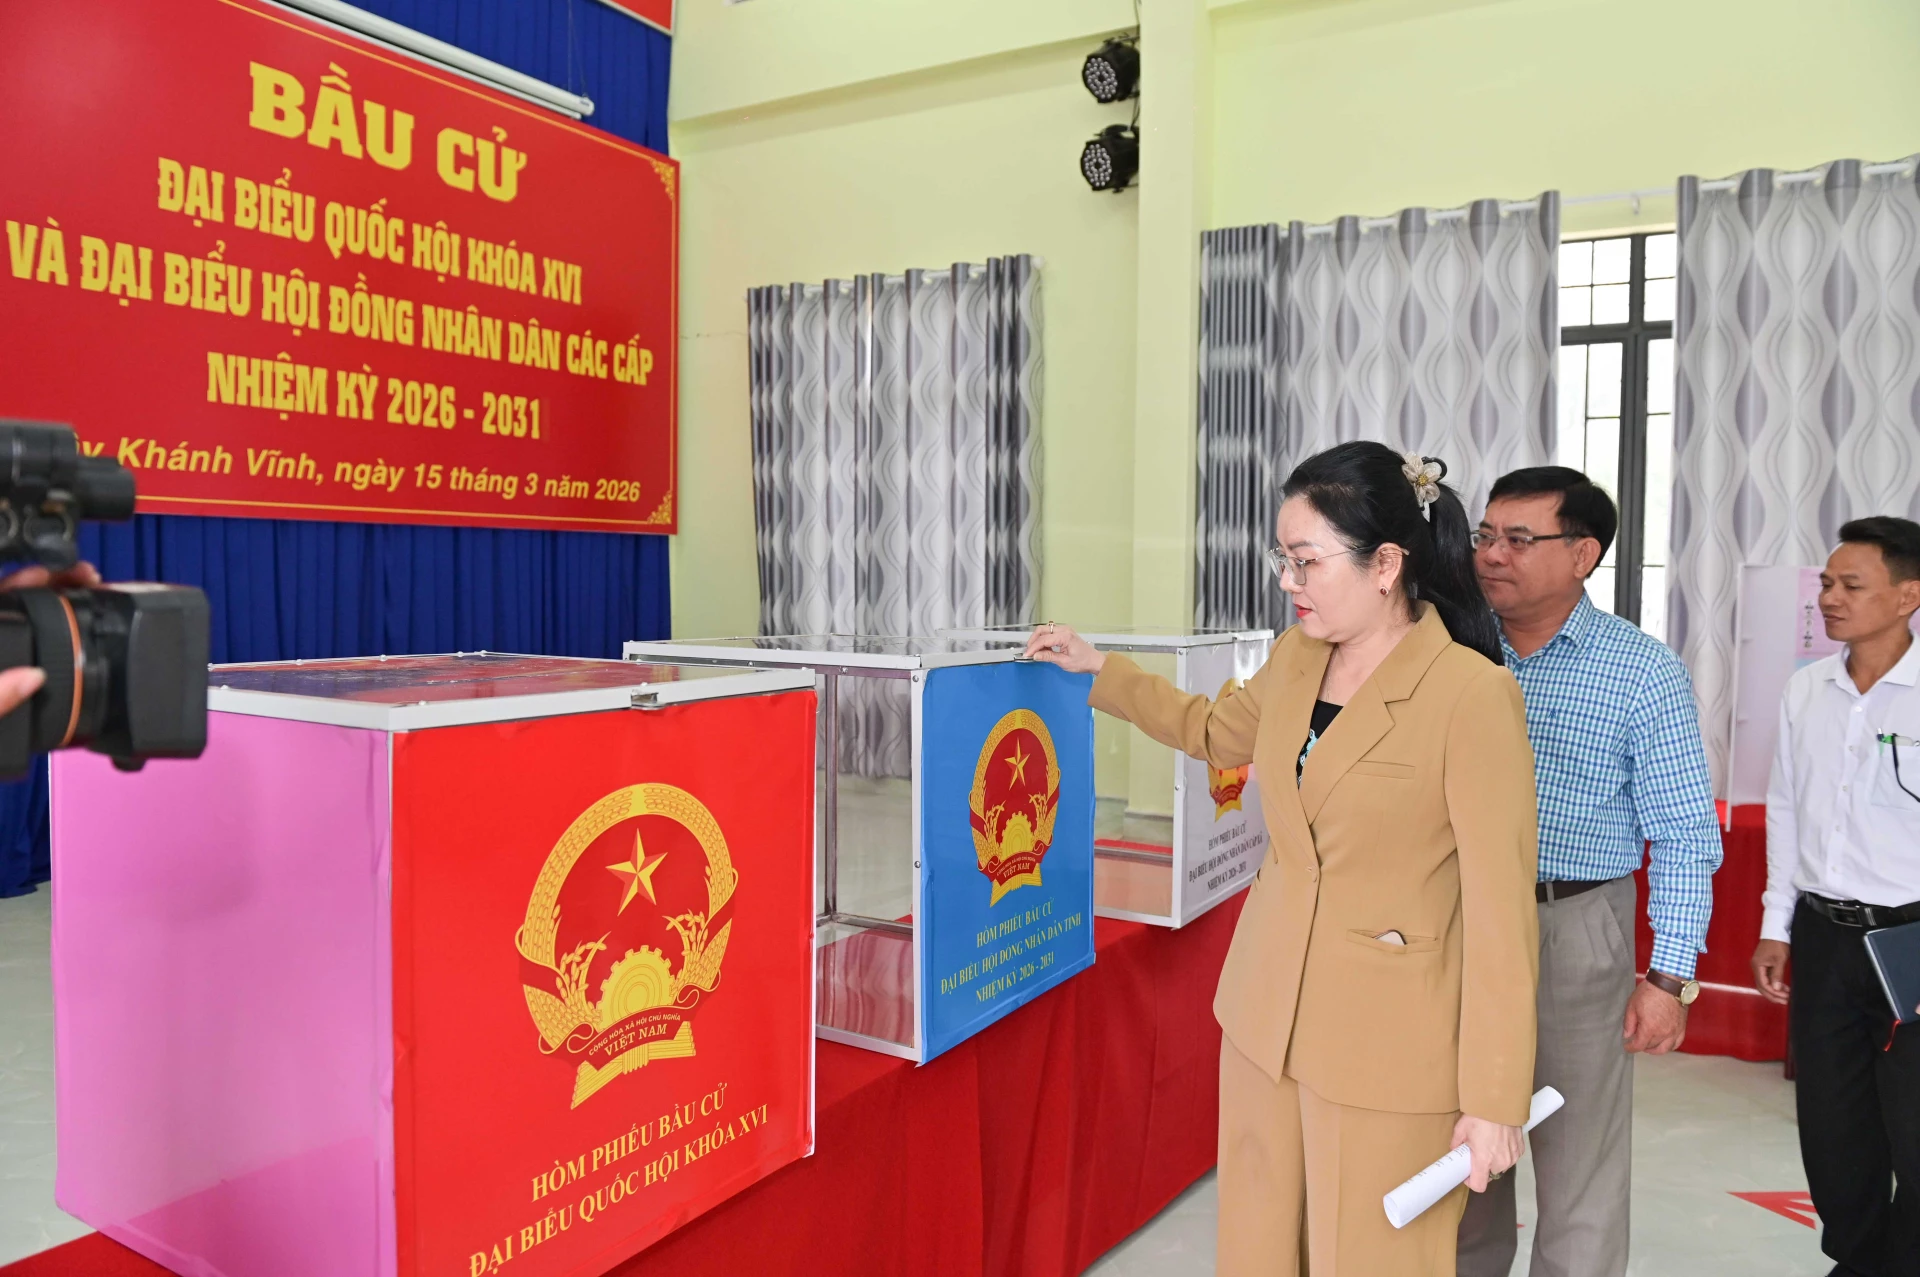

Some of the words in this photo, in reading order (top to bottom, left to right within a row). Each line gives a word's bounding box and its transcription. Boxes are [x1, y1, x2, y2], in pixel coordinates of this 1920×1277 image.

[249, 61, 414, 170] BẦU
[437, 126, 527, 202] CỬ
[158, 157, 224, 228] ĐẠI
[234, 167, 316, 242] BIỂU
[325, 198, 404, 265] QUỐC
[412, 220, 460, 283] HỘI
[467, 240, 537, 295] KHÓA
[543, 257, 582, 305] XVI
[6, 216, 69, 286] VÀ
[80, 235, 153, 307] ĐẠI
[164, 240, 252, 317] BIỂU
[262, 268, 320, 336] HỘI
[329, 272, 414, 346] ĐỒNG
[422, 305, 502, 361] NHÂN
[508, 317, 561, 371] DÂN
[567, 330, 608, 379] CÁC
[613, 334, 653, 386] CẤP
[207, 351, 328, 421] NHIỆM
[336, 363, 379, 420] KỲ
[387, 377, 456, 429] 2026
[463, 408, 475, 419] -
[482, 391, 540, 439] 2031
[117, 437, 233, 474] Khánh
[246, 448, 323, 486] Vĩnh,
[334, 458, 404, 492] ngày
[413, 463, 443, 489] 15
[449, 467, 518, 500] tháng
[524, 472, 539, 495] 3
[543, 474, 589, 498] năm
[594, 478, 641, 502] 2026
[1017, 862, 1030, 872] NAM
[941, 972, 957, 995] ĐẠI
[982, 952, 998, 974] HỘI
[1025, 927, 1046, 952] NHÂN
[1047, 919, 1063, 941] DÂN
[977, 925, 997, 948] HÒM
[976, 976, 1004, 1005] NHIỆM
[1019, 960, 1034, 981] 2026
[1040, 951, 1055, 970] 2031
[589, 1037, 608, 1055] CỘNG
[609, 1027, 624, 1040] HÒA
[636, 1015, 647, 1026] HỘI
[648, 1012, 661, 1022] CHỦ
[604, 1032, 636, 1056] VIỆT
[638, 1024, 667, 1040] NAM
[531, 1160, 586, 1202] HÒM
[591, 1123, 653, 1172] PHIẾU
[658, 1103, 696, 1139] BẦU
[700, 1082, 727, 1116] CỬ
[469, 1243, 513, 1277] ĐẠI
[519, 1207, 573, 1254] BIỂU
[579, 1173, 639, 1223] QUỐC
[644, 1151, 679, 1187] HỘI
[684, 1121, 735, 1166] KHÓA
[739, 1103, 768, 1137] XVI
